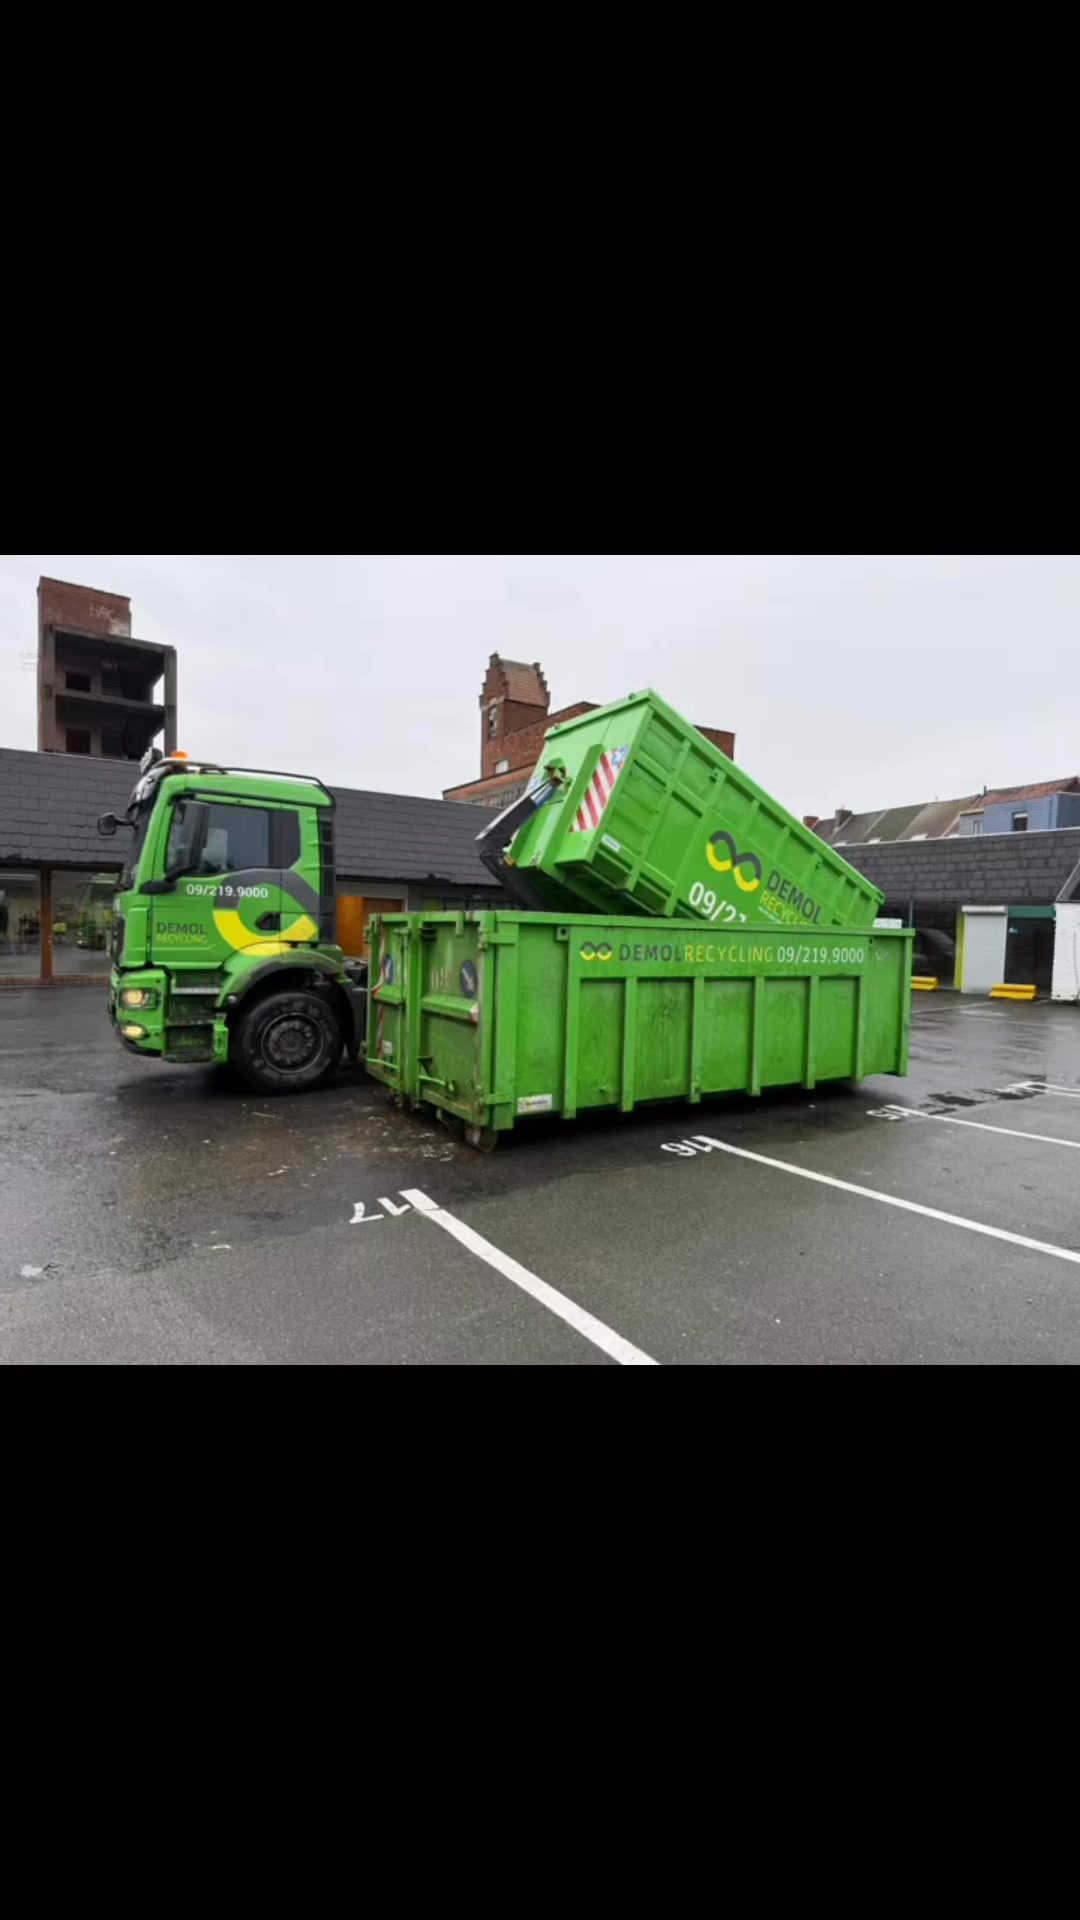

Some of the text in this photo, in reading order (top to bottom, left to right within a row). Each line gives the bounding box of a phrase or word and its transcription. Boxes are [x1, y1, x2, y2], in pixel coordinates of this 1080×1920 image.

[185, 883, 269, 898] 09/219.9000
[767, 869, 821, 925] DEMOL
[156, 921, 208, 935] DEMOL
[777, 946, 865, 965] 09/219.9000
